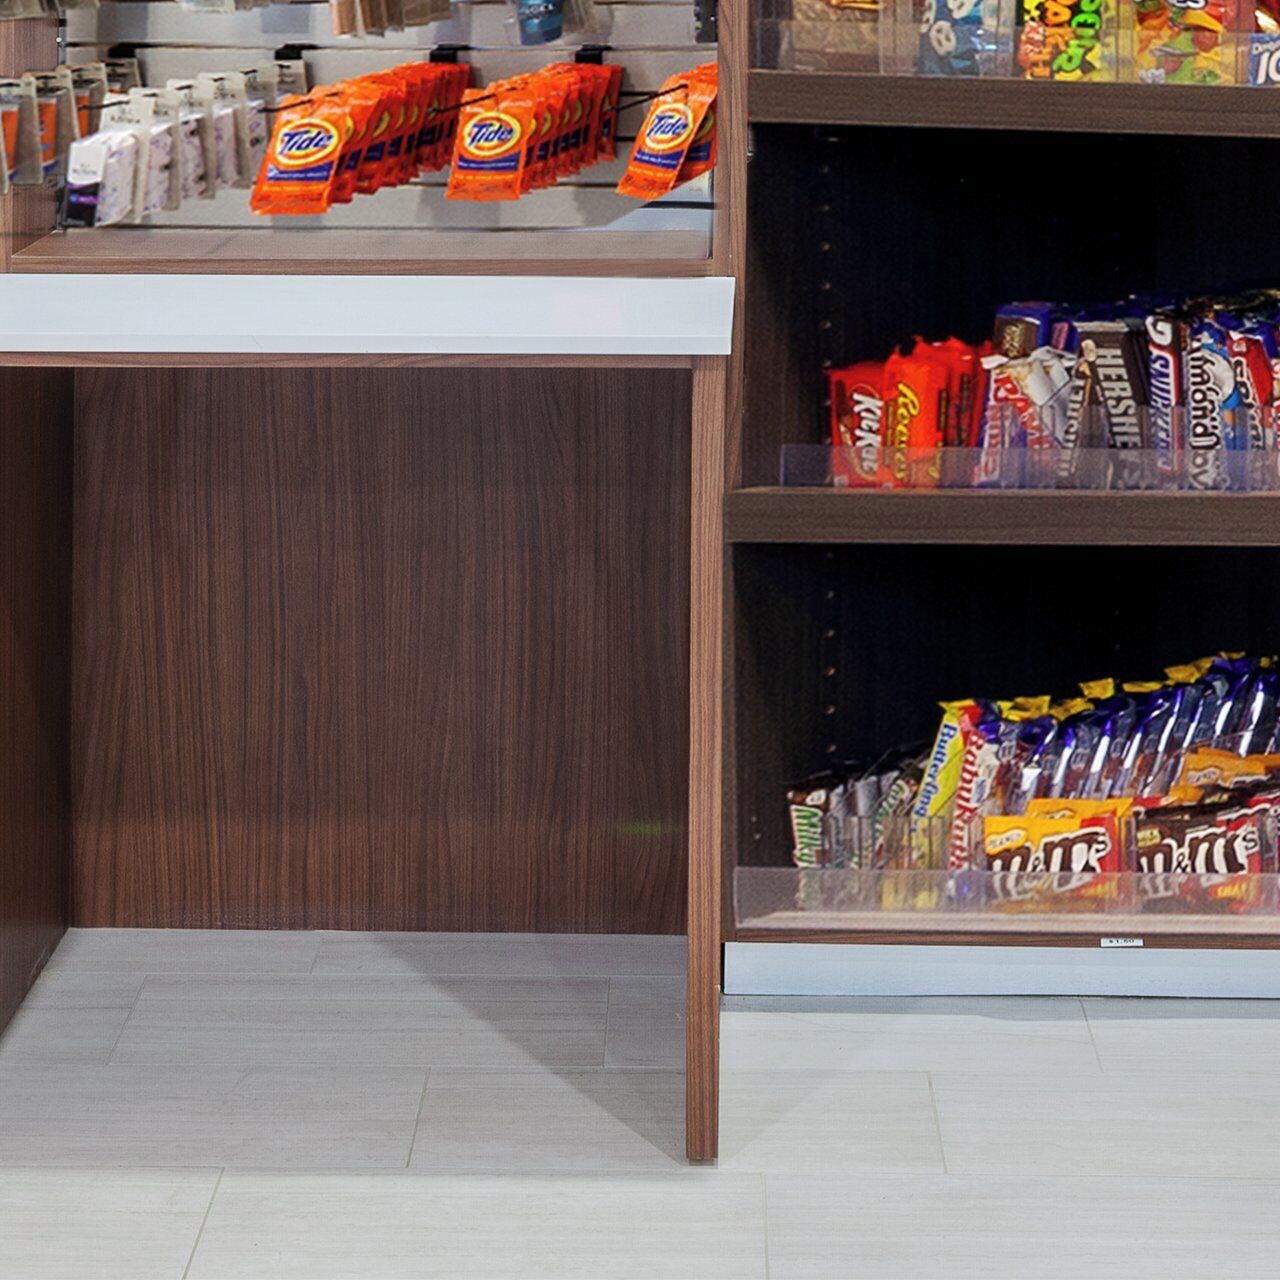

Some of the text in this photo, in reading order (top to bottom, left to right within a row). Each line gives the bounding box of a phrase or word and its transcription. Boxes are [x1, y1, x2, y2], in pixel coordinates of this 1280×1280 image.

[468, 123, 514, 148] Tide
[649, 111, 691, 139] Tide
[279, 128, 334, 156] Tide
[1096, 348, 1144, 465] HERSHE
